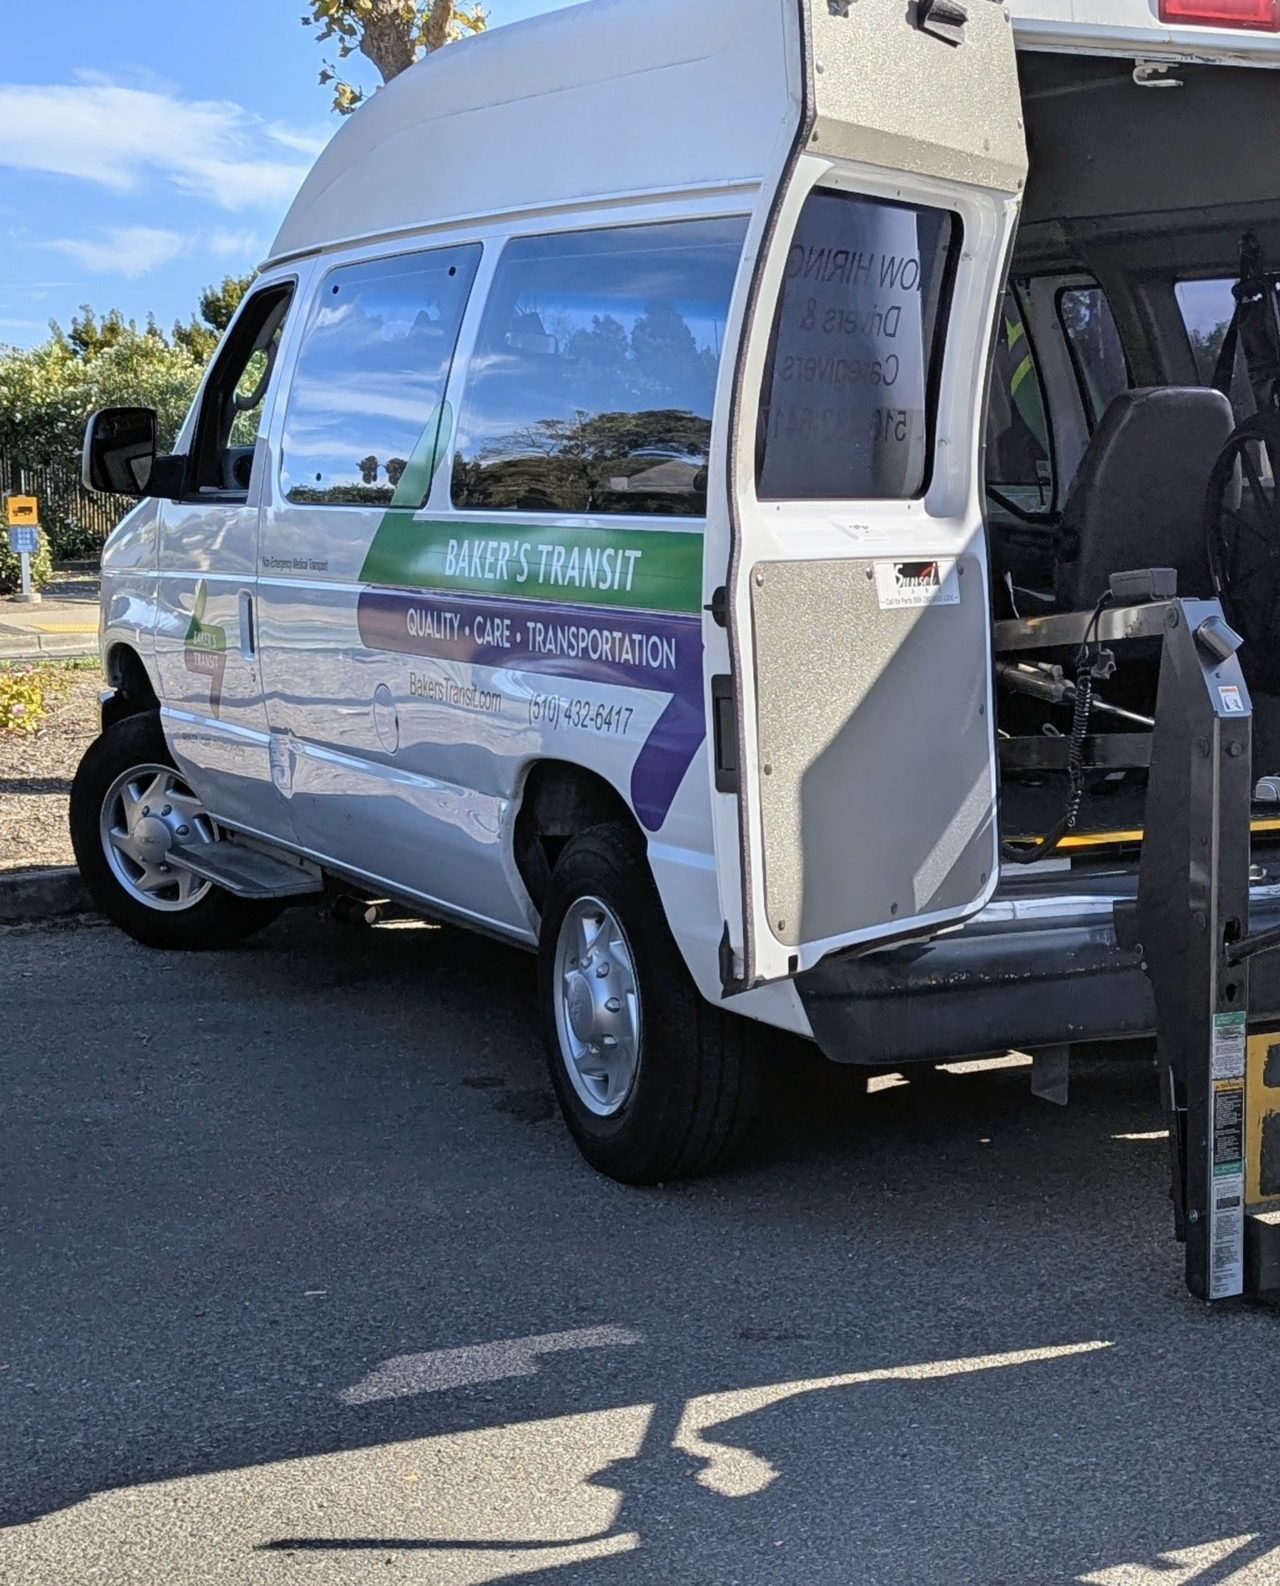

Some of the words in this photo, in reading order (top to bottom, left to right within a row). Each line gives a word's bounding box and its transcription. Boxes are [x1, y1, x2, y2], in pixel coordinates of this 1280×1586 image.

[444, 539, 531, 583] BAKER'S
[537, 544, 642, 591] TRANSIT
[407, 608, 460, 641] QUALITY
[473, 615, 511, 648] CARE
[526, 621, 676, 670] TRANSPORTATION
[409, 672, 502, 713] BakersTransit.com
[528, 692, 561, 730] (510)
[564, 698, 634, 735] 432-6417
